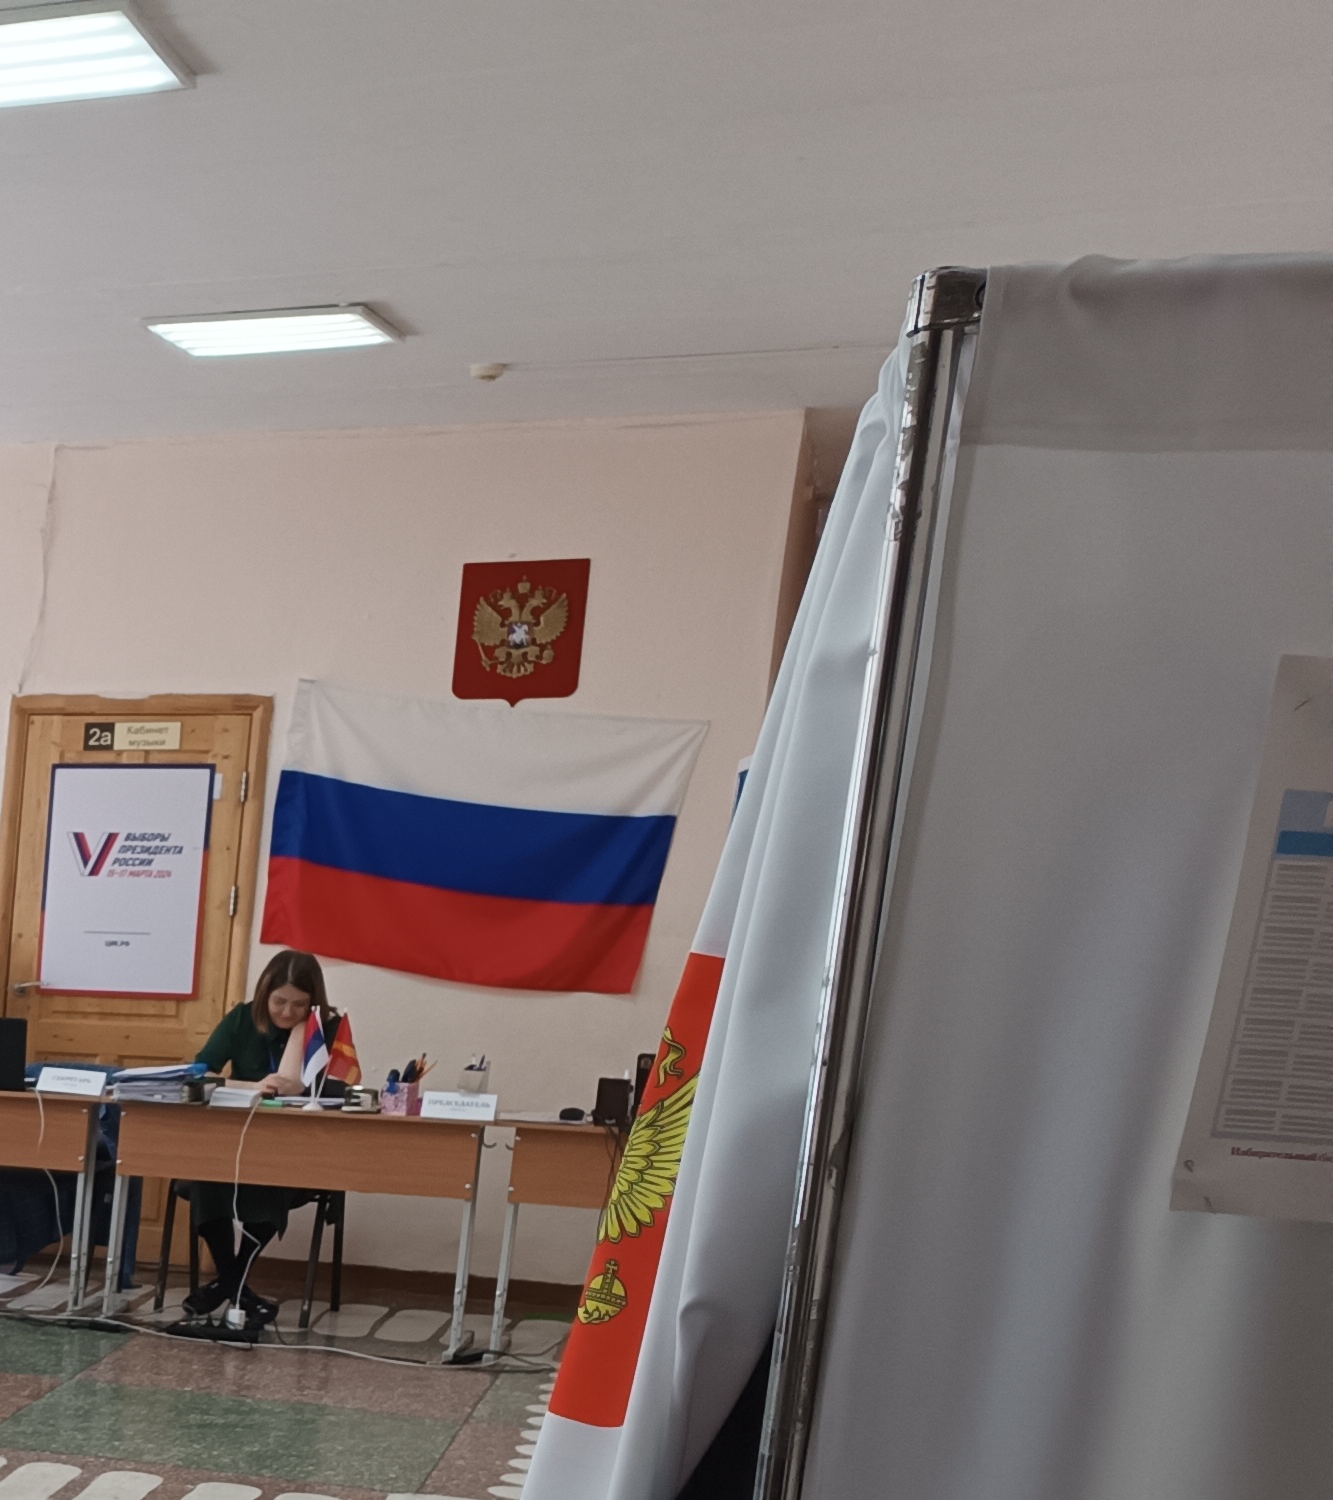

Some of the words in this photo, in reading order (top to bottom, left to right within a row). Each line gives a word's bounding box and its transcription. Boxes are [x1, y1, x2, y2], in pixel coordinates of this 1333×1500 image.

[126, 725, 169, 735] Кабинет
[88, 727, 112, 746] 2а
[128, 739, 166, 748] музыки
[124, 832, 172, 842] ВЫБОРЫ
[117, 845, 184, 856] ПРЕЗИДЕНТА
[111, 857, 154, 867] РОССИИ
[128, 869, 154, 878] МАРТА
[427, 1099, 491, 1108] ПРЕДСЕДАТЕЛЬ
